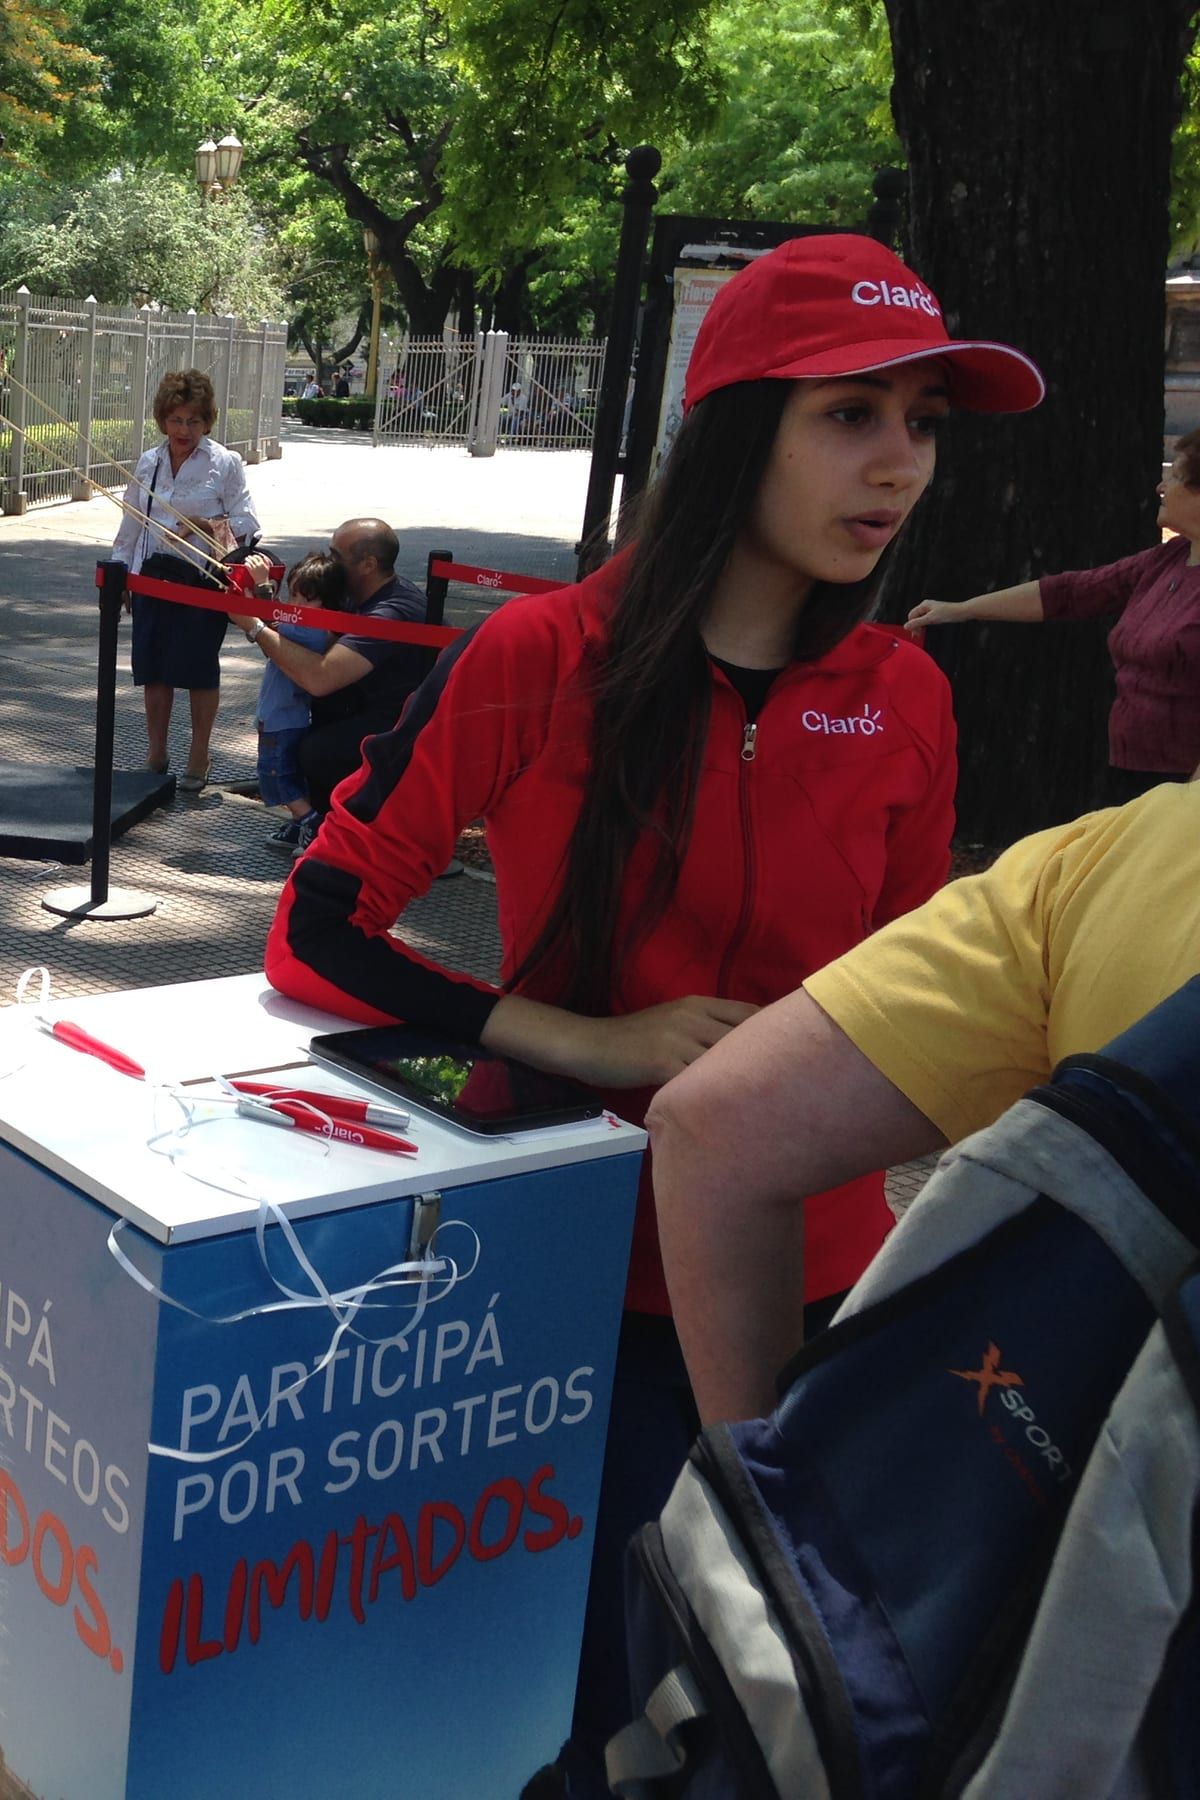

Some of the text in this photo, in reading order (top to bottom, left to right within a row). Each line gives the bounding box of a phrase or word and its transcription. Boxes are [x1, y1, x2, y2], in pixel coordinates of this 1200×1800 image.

[851, 280, 935, 317] Claro
[476, 574, 500, 588] Claro
[273, 607, 300, 624] Claro
[802, 707, 879, 736] Claro
[322, 1124, 364, 1144] Claro
[180, 1291, 505, 1451] PARTICIPÁ
[173, 1366, 595, 1542] POR SORTEOS
[999, 1387, 1074, 1485] SPORT
[159, 1464, 584, 1676] ILIMITADOS.
